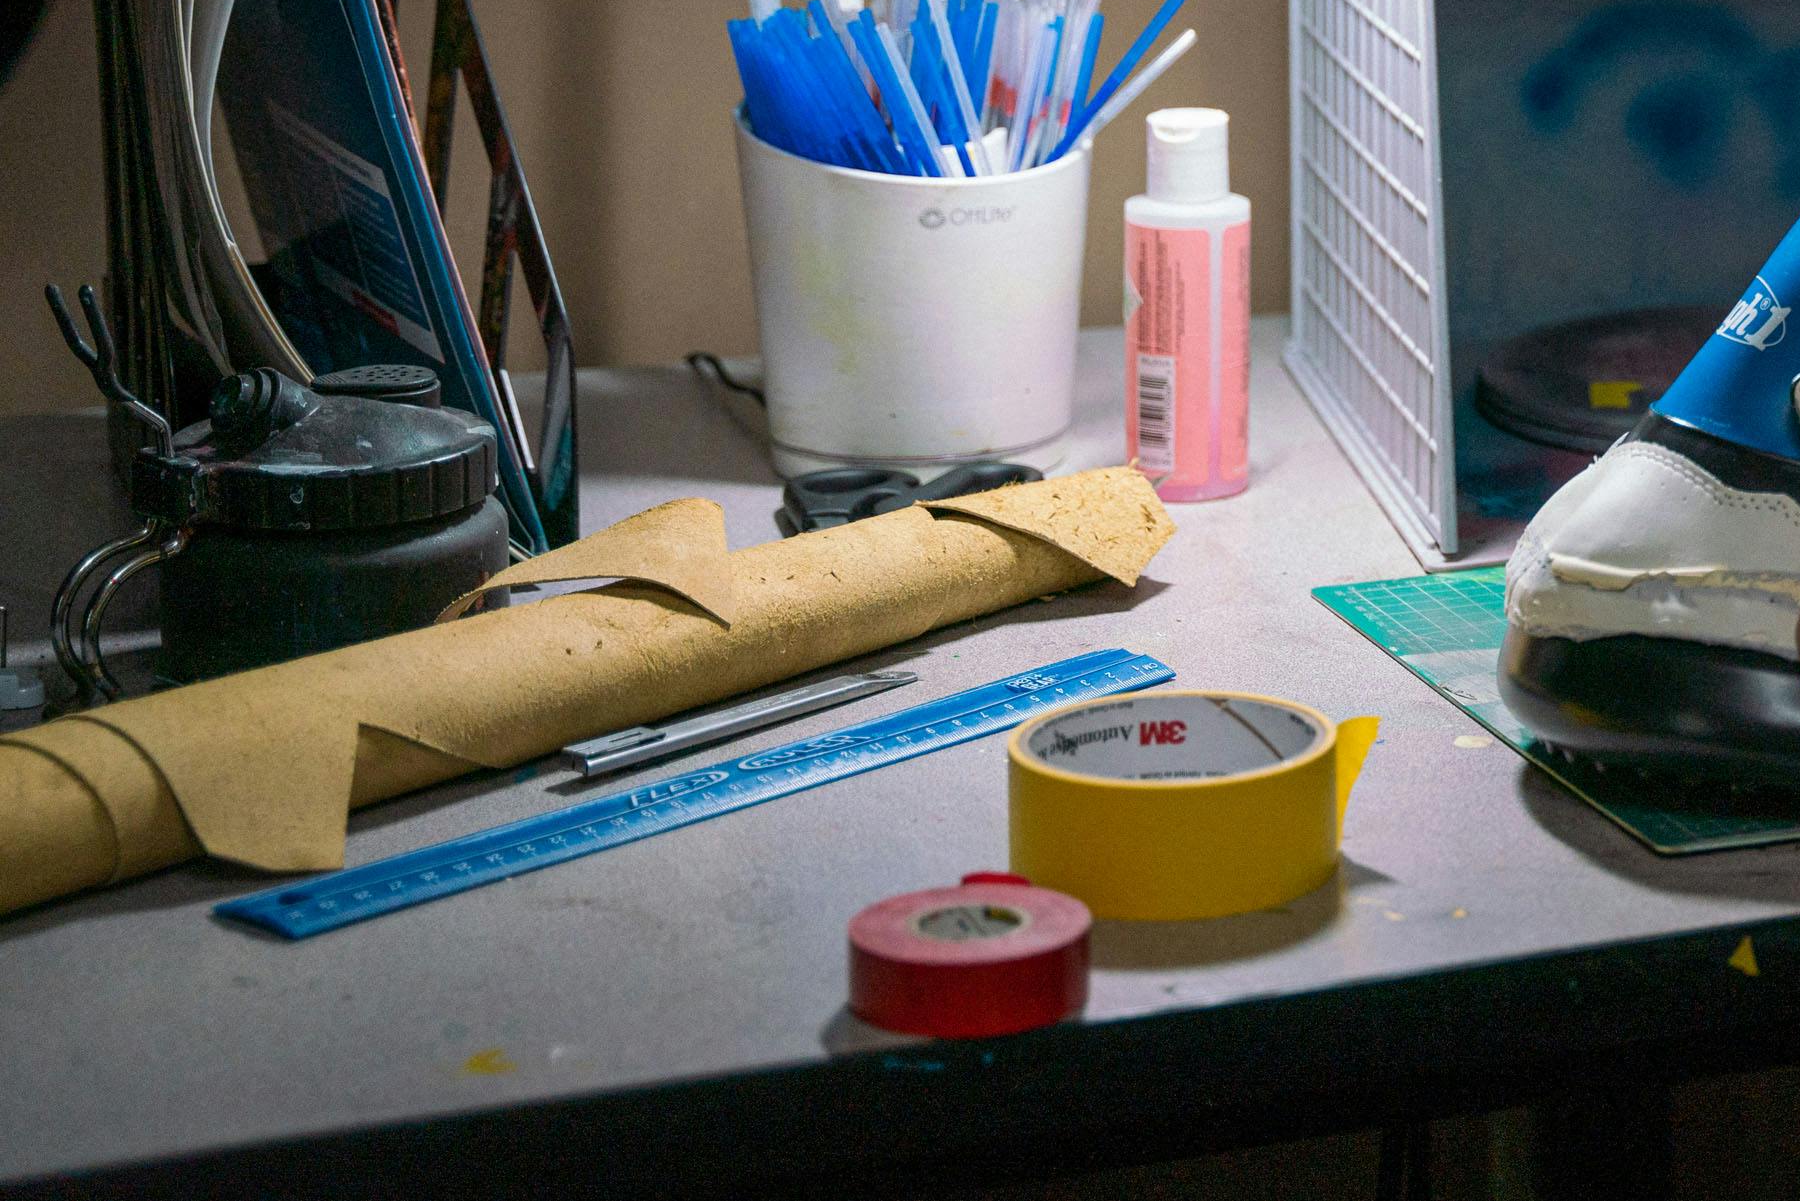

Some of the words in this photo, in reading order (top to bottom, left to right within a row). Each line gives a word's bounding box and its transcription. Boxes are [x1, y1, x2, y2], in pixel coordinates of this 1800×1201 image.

[1142, 663, 1159, 672] CM
[1104, 671, 1116, 680] 2
[1080, 679, 1091, 687] 3
[1055, 687, 1064, 695] 4
[1004, 703, 1014, 711] 6
[951, 719, 962, 727] 8
[1139, 720, 1187, 746] 3M
[896, 734, 911, 743] 10
[869, 742, 884, 750] 11
[630, 773, 721, 807] FLEXI
